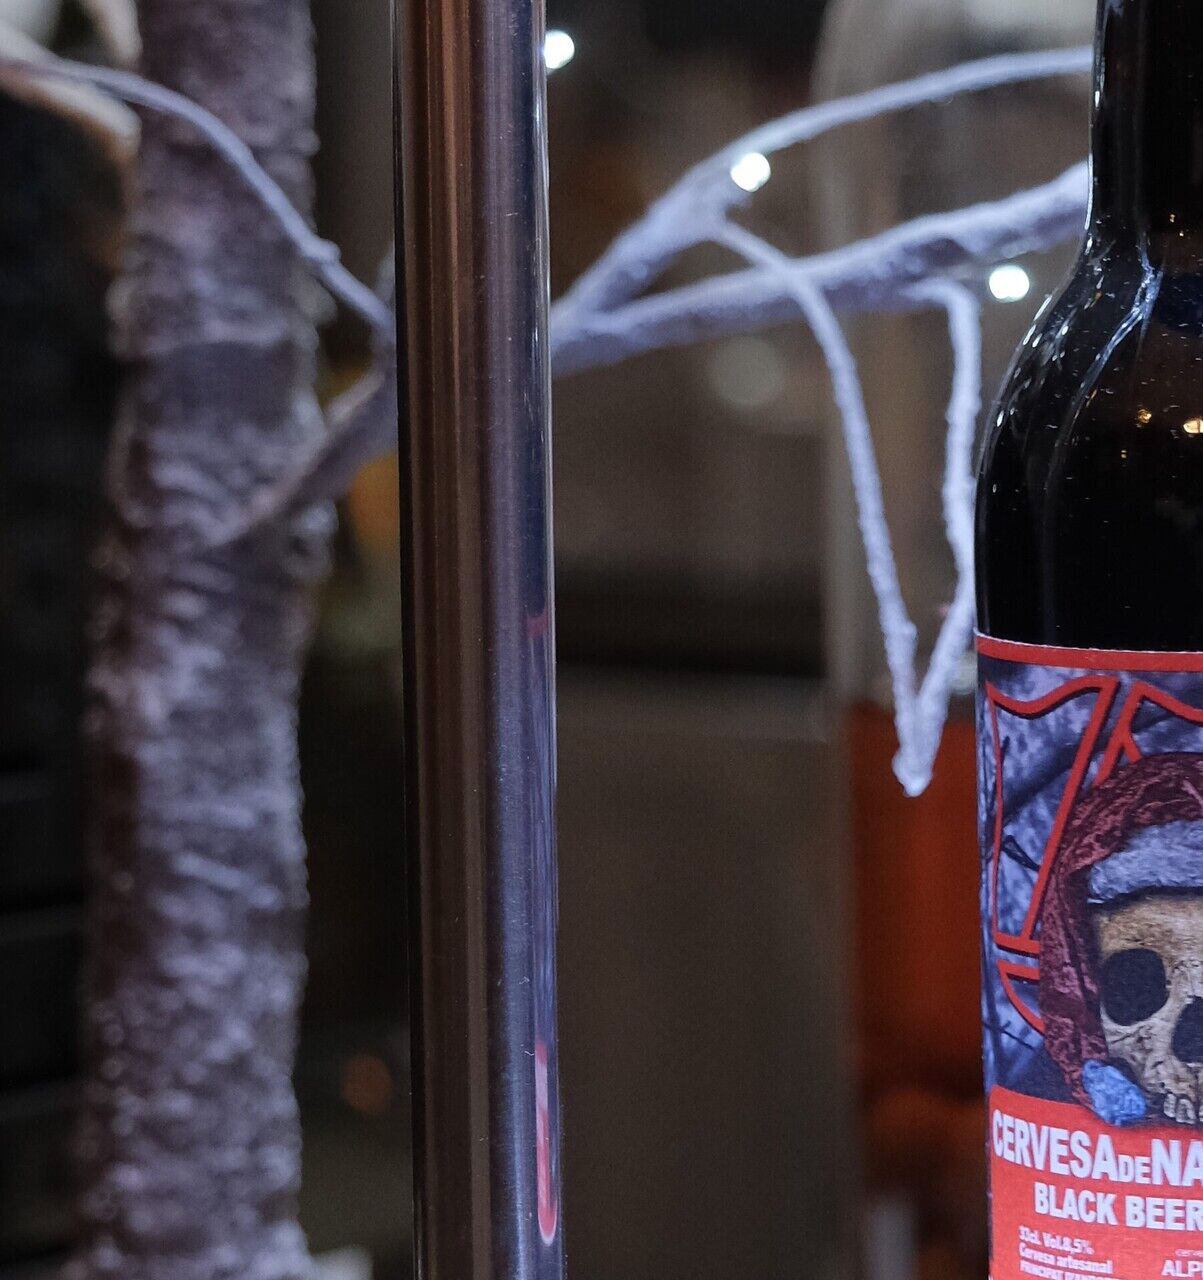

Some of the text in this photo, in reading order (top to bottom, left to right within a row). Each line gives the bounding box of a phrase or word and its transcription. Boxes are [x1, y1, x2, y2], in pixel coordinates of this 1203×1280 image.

[1034, 1181, 1118, 1226] BLACK
[1018, 1242, 1114, 1274] Cervesa artesanal
